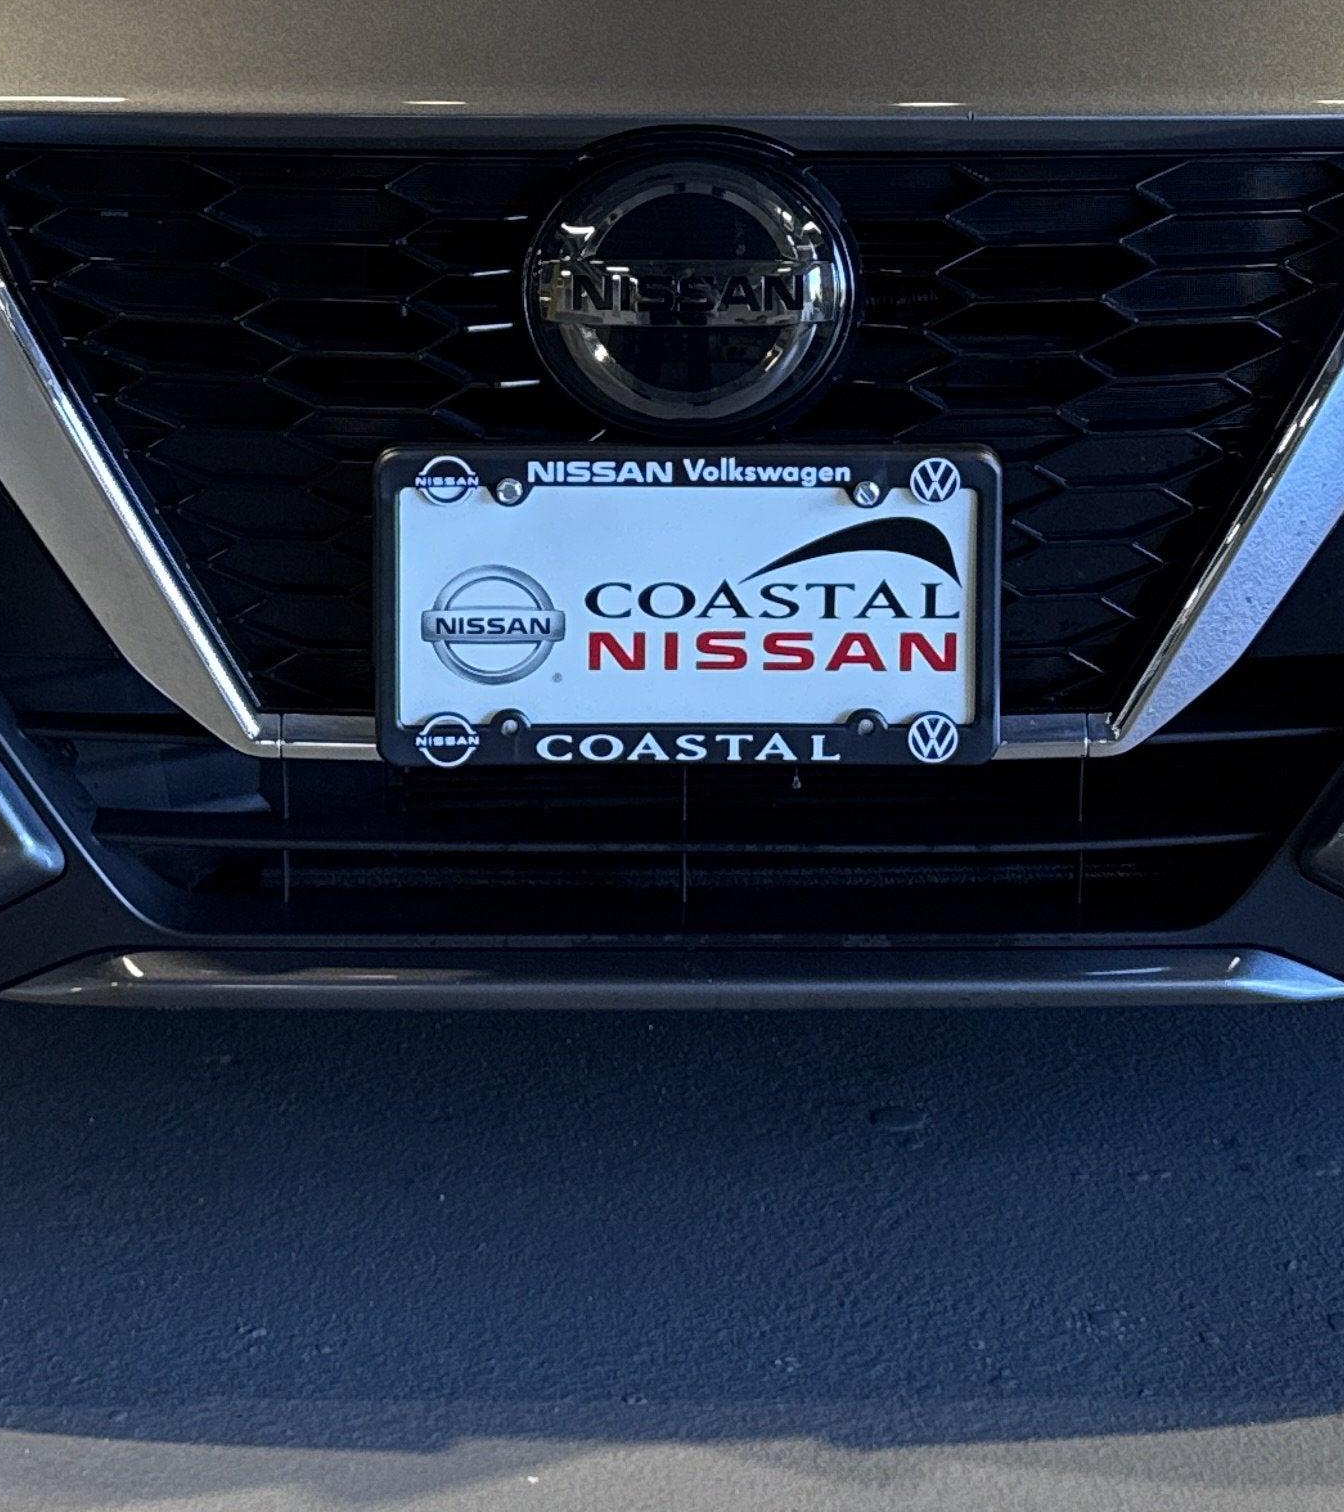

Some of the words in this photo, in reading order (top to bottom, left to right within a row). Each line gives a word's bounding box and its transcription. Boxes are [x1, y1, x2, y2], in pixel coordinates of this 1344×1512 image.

[571, 274, 805, 312] NISSAN
[415, 475, 480, 487] NISSAN
[528, 461, 673, 483] NISSAN
[683, 458, 851, 486] Volkswagen
[584, 579, 961, 620] COASTAL
[434, 617, 552, 636] NISSAN
[587, 631, 958, 672] NISSAN
[415, 735, 480, 747] NISSAN
[536, 733, 841, 762] COASTAL
